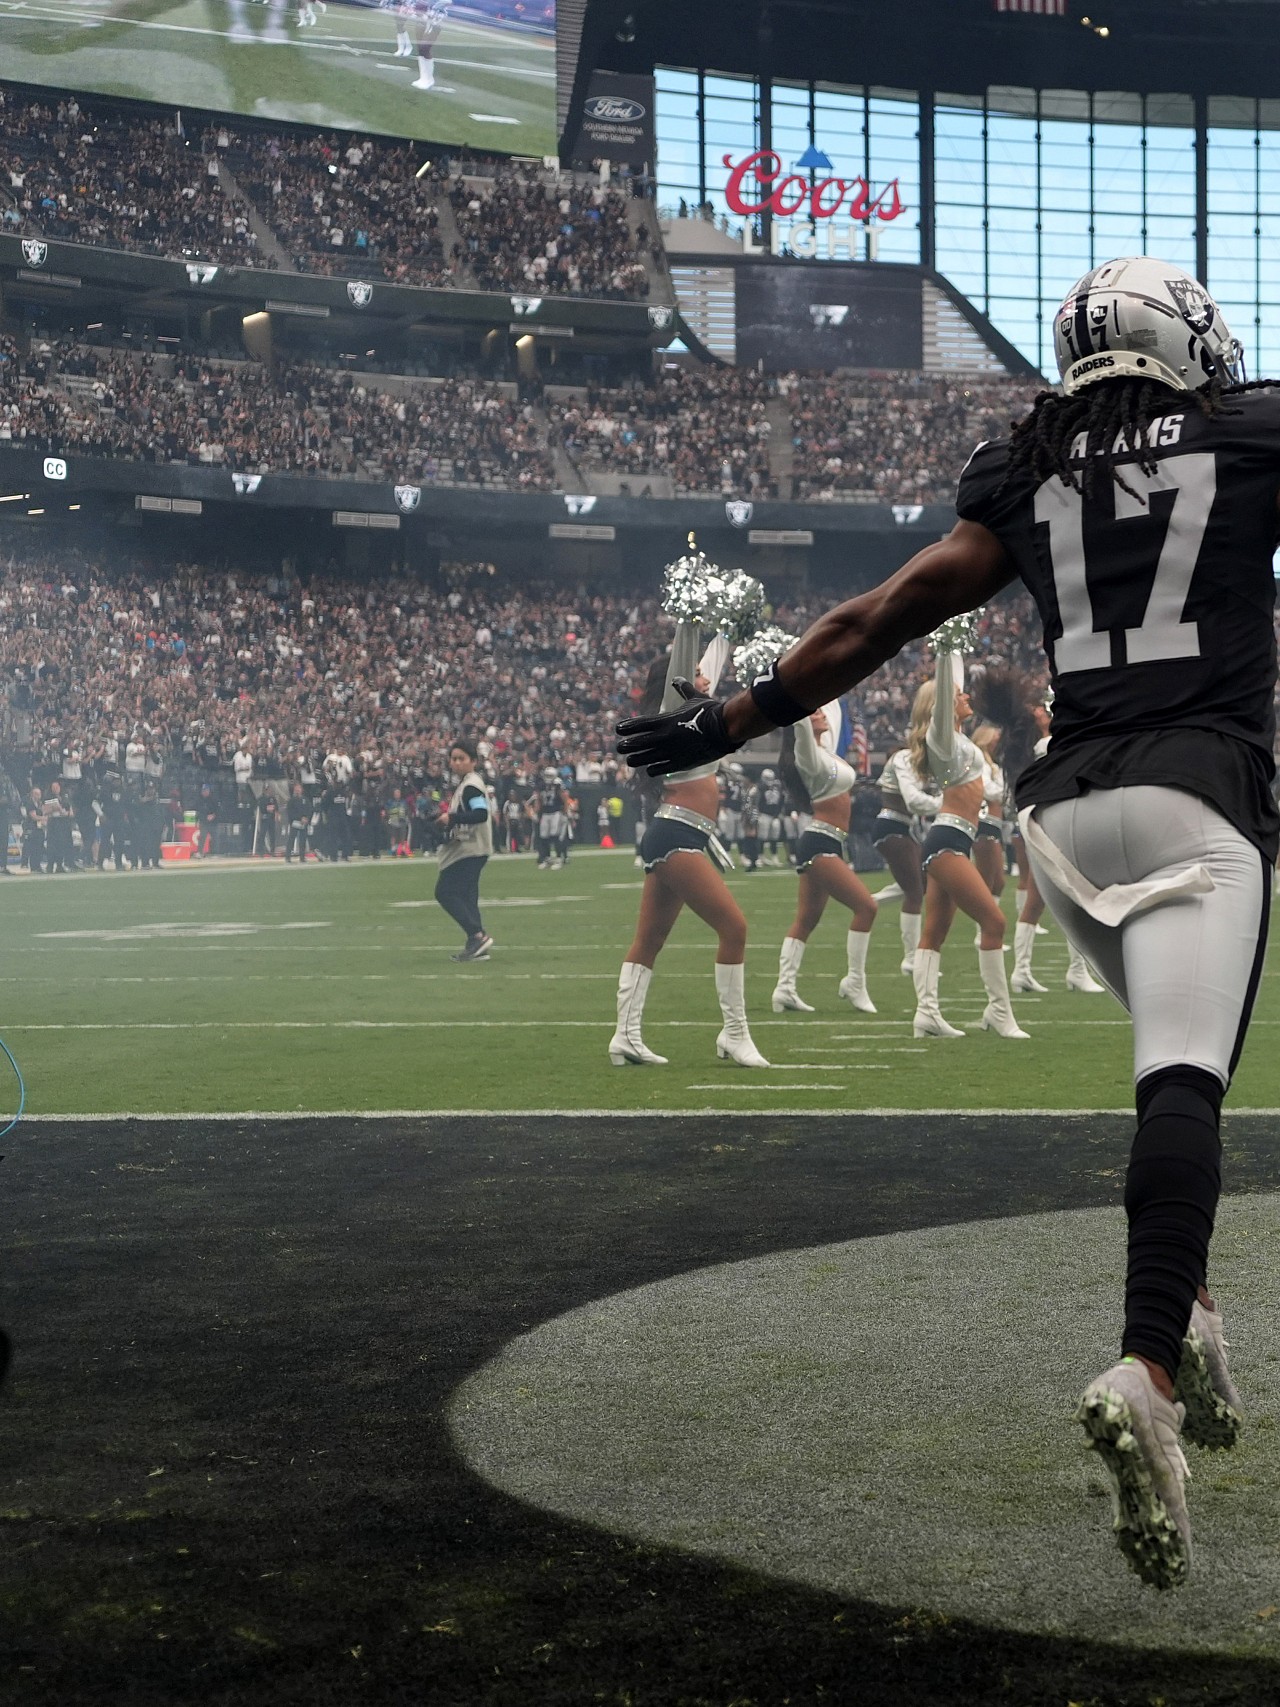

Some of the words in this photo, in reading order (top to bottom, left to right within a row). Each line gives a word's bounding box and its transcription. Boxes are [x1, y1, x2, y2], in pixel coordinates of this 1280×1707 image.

[593, 100, 634, 118] Ford
[722, 150, 906, 221] Coors
[742, 219, 885, 261] LIGHT
[1071, 356, 1115, 380] RAIDERS
[1069, 414, 1185, 459] AAMS
[46, 462, 64, 476] CC
[1034, 452, 1218, 675] 17
